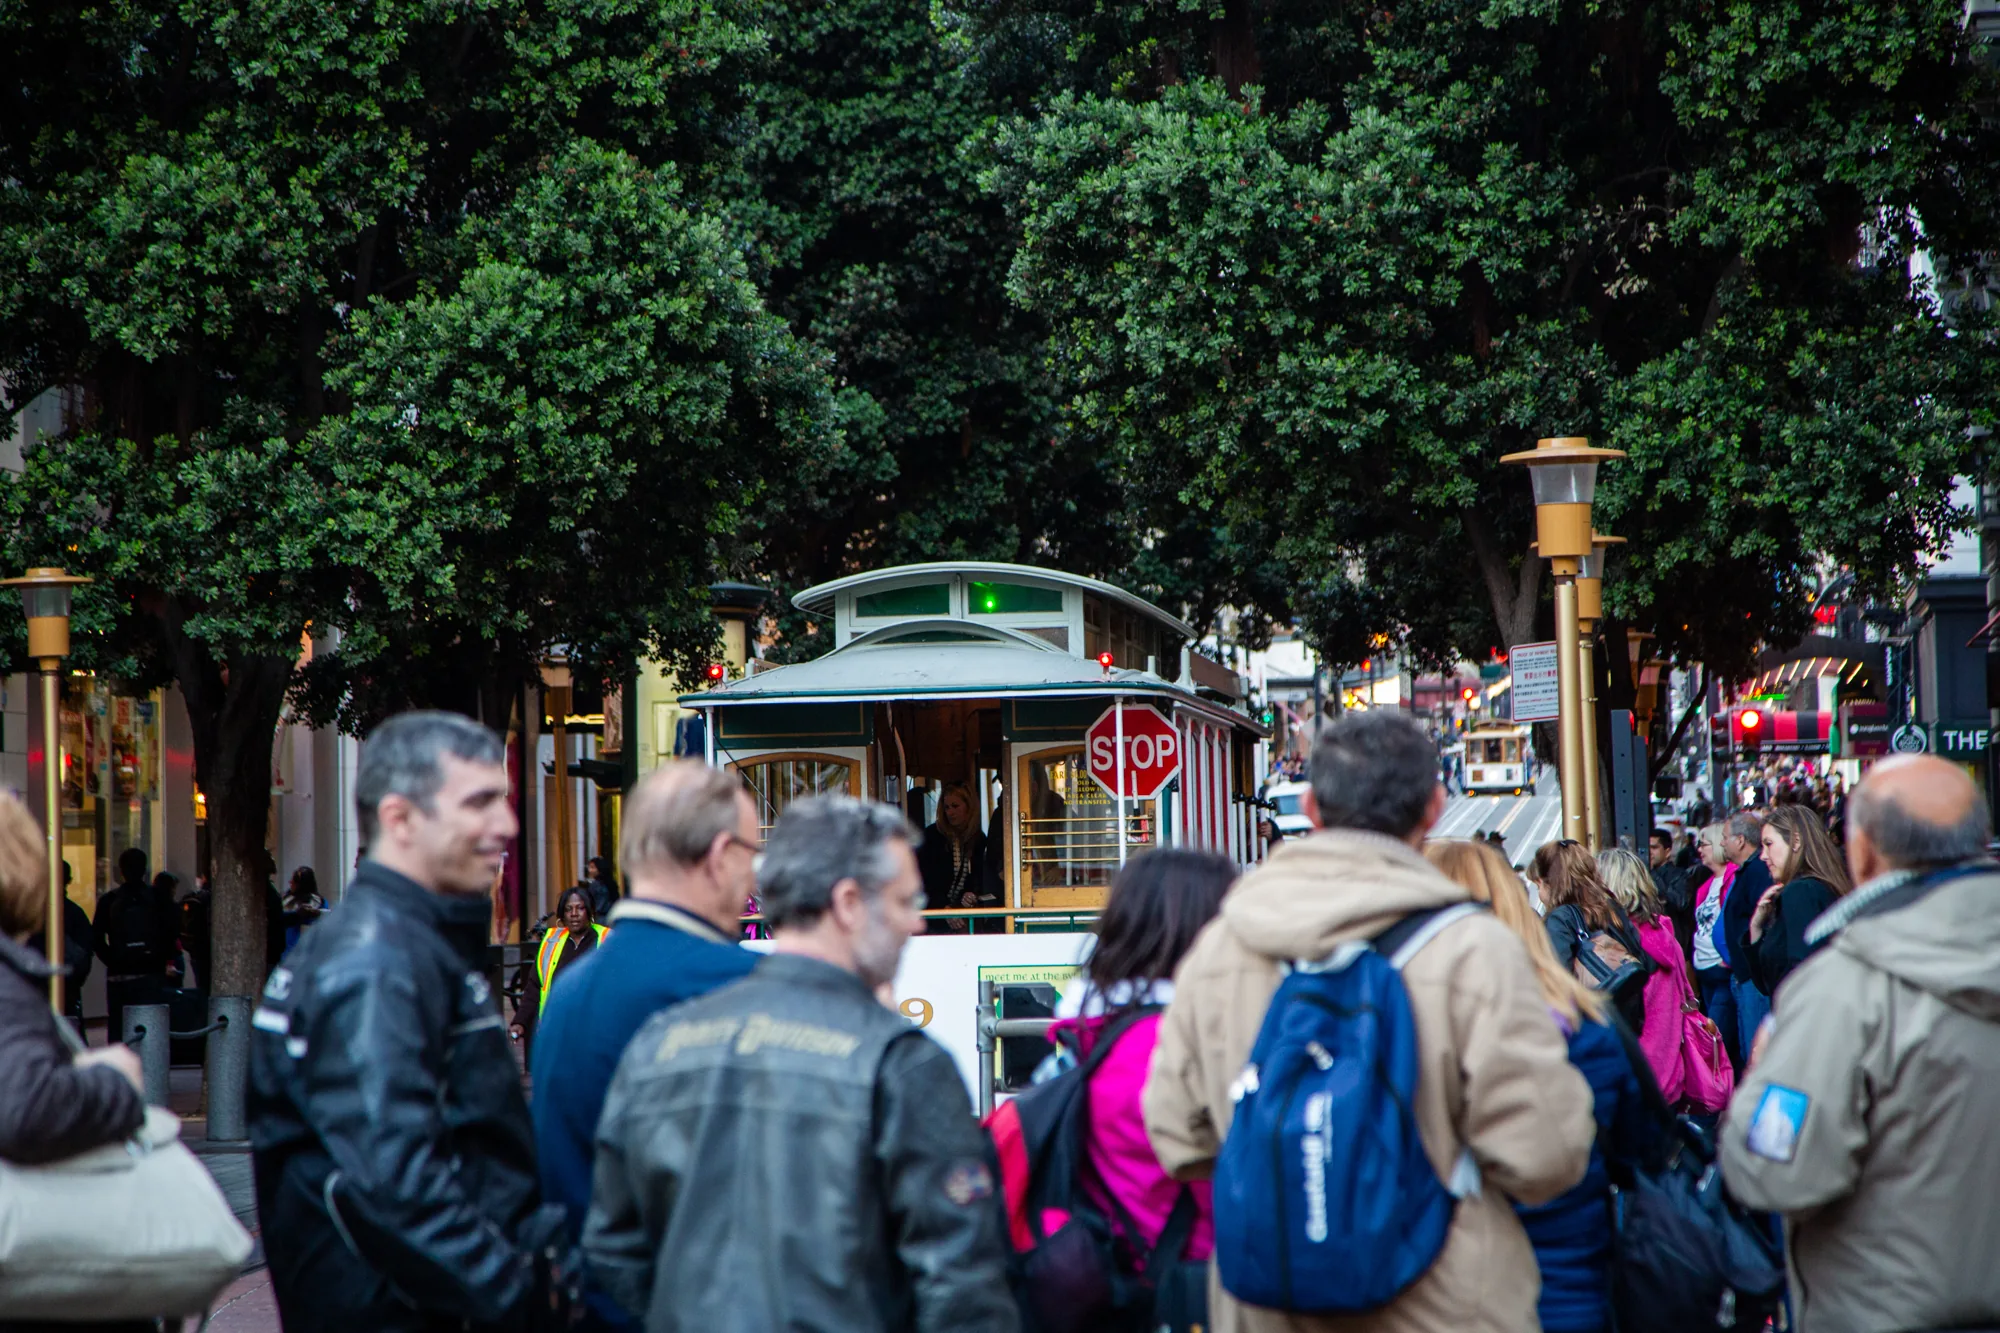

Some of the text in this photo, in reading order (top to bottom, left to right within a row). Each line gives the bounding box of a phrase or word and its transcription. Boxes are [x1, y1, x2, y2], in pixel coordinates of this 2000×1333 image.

[1942, 729, 1989, 751] THE
[1092, 734, 1175, 771] STOP
[985, 973, 1010, 982] meet
[1013, 973, 1028, 981] me
[1043, 972, 1060, 981] the
